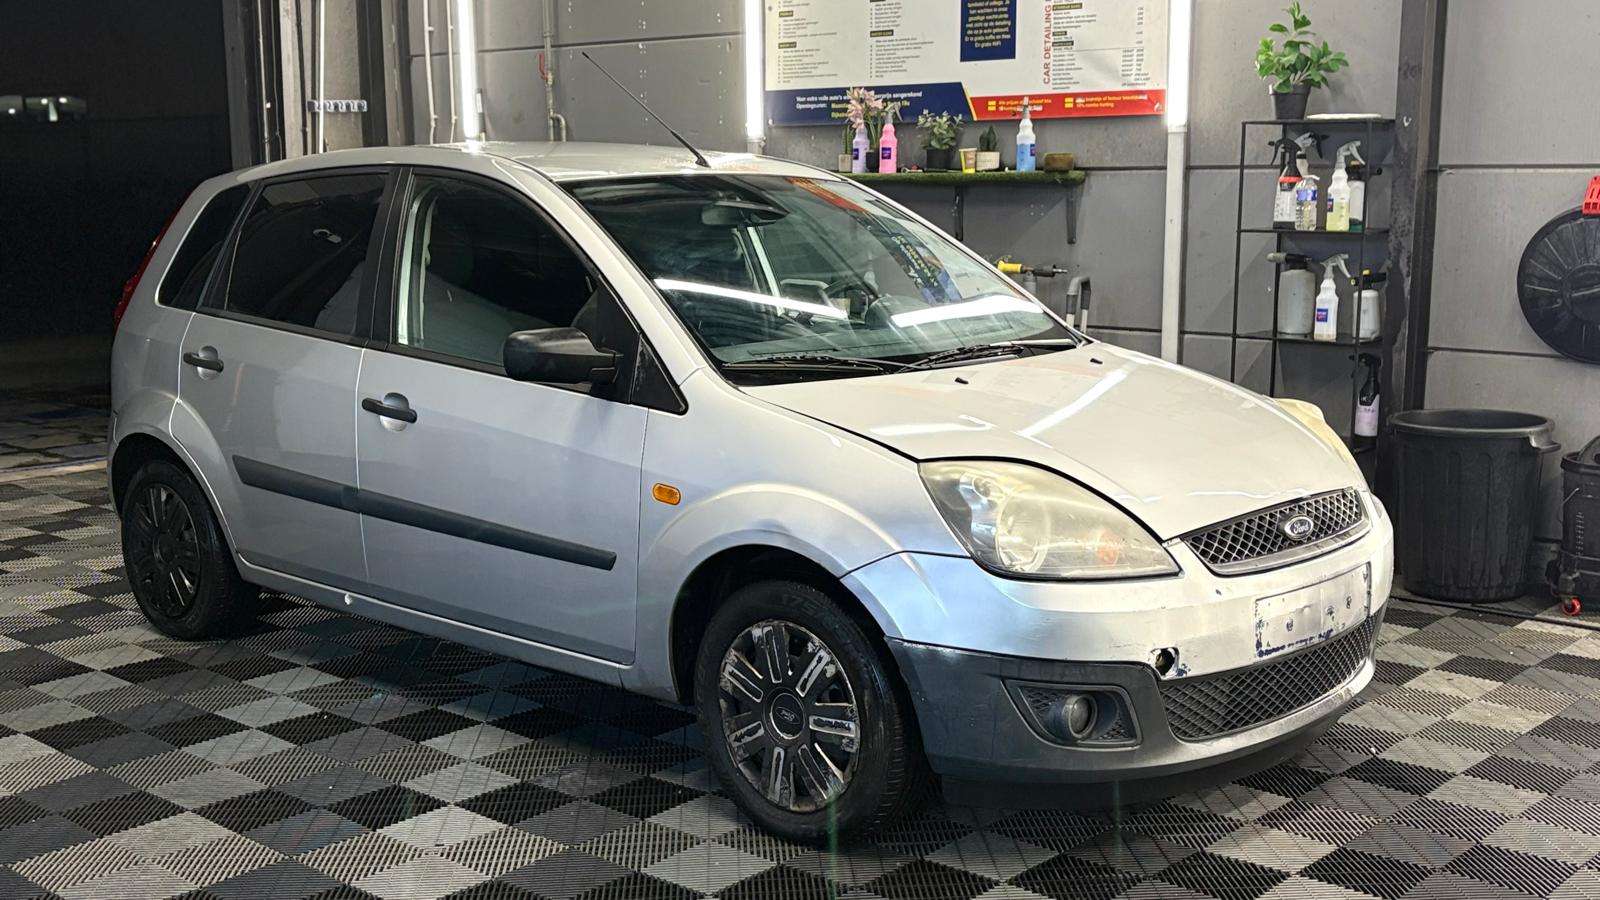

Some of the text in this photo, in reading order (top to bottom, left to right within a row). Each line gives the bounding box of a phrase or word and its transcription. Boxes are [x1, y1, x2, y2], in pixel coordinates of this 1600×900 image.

[1043, 5, 1052, 85] CAR DETAILING
[1293, 521, 1309, 534] Ford
